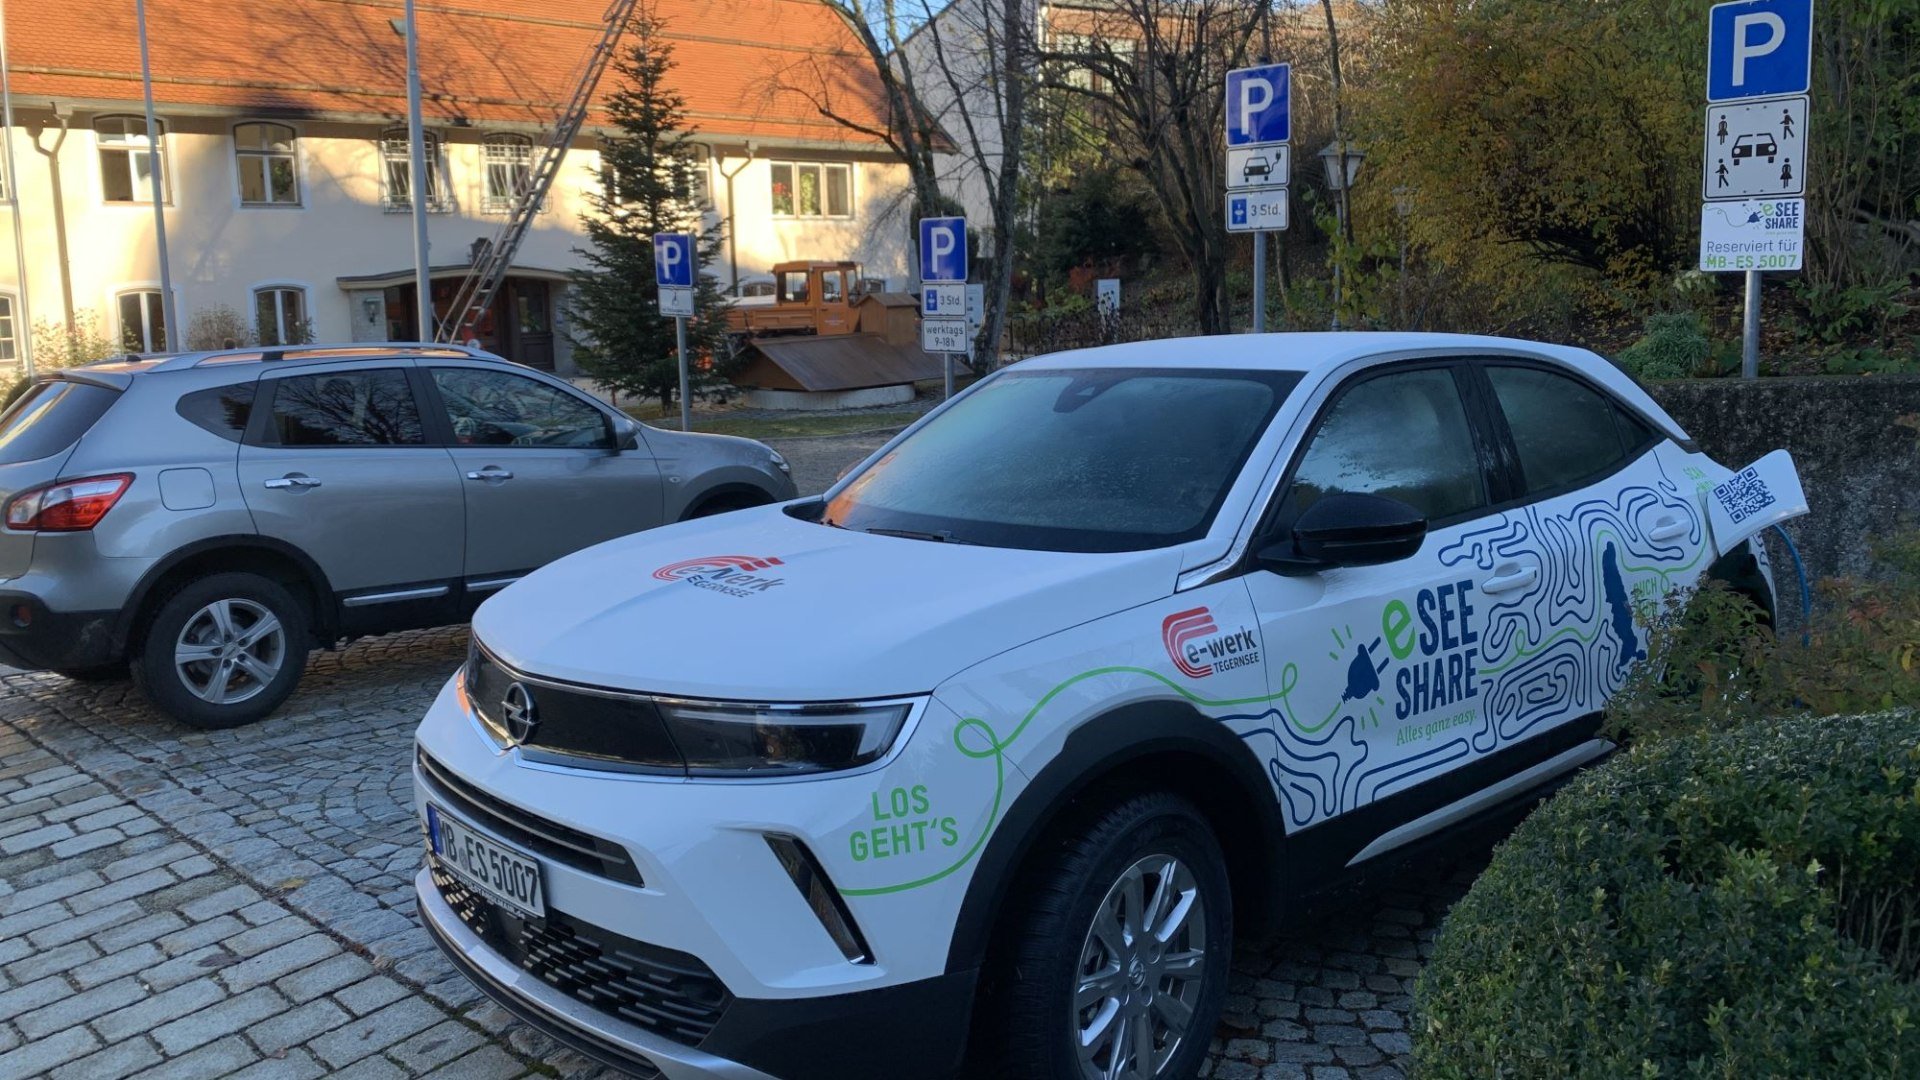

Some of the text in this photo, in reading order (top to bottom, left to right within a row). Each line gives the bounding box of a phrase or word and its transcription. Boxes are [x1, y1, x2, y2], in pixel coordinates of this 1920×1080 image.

[1732, 11, 1786, 87] P
[1240, 77, 1274, 136] P
[1250, 203, 1281, 217] 3 Std.
[1764, 216, 1799, 230] SHARE
[662, 240, 682, 280] P
[931, 226, 956, 274] P
[1705, 254, 1798, 269] MB-ES 5007
[1706, 238, 1798, 253] Reserviert für
[940, 295, 962, 306] 3 Std.
[925, 325, 964, 337] werktags
[1185, 625, 1257, 664] e-werk
[1213, 651, 1260, 673] TEGERNSEE
[1396, 648, 1478, 721] SHARE
[1396, 708, 1477, 747] Alles ganz easy.
[871, 784, 930, 821] LOS
[438, 818, 458, 862] MB
[464, 835, 489, 883] ES
[488, 848, 538, 908] 5007
